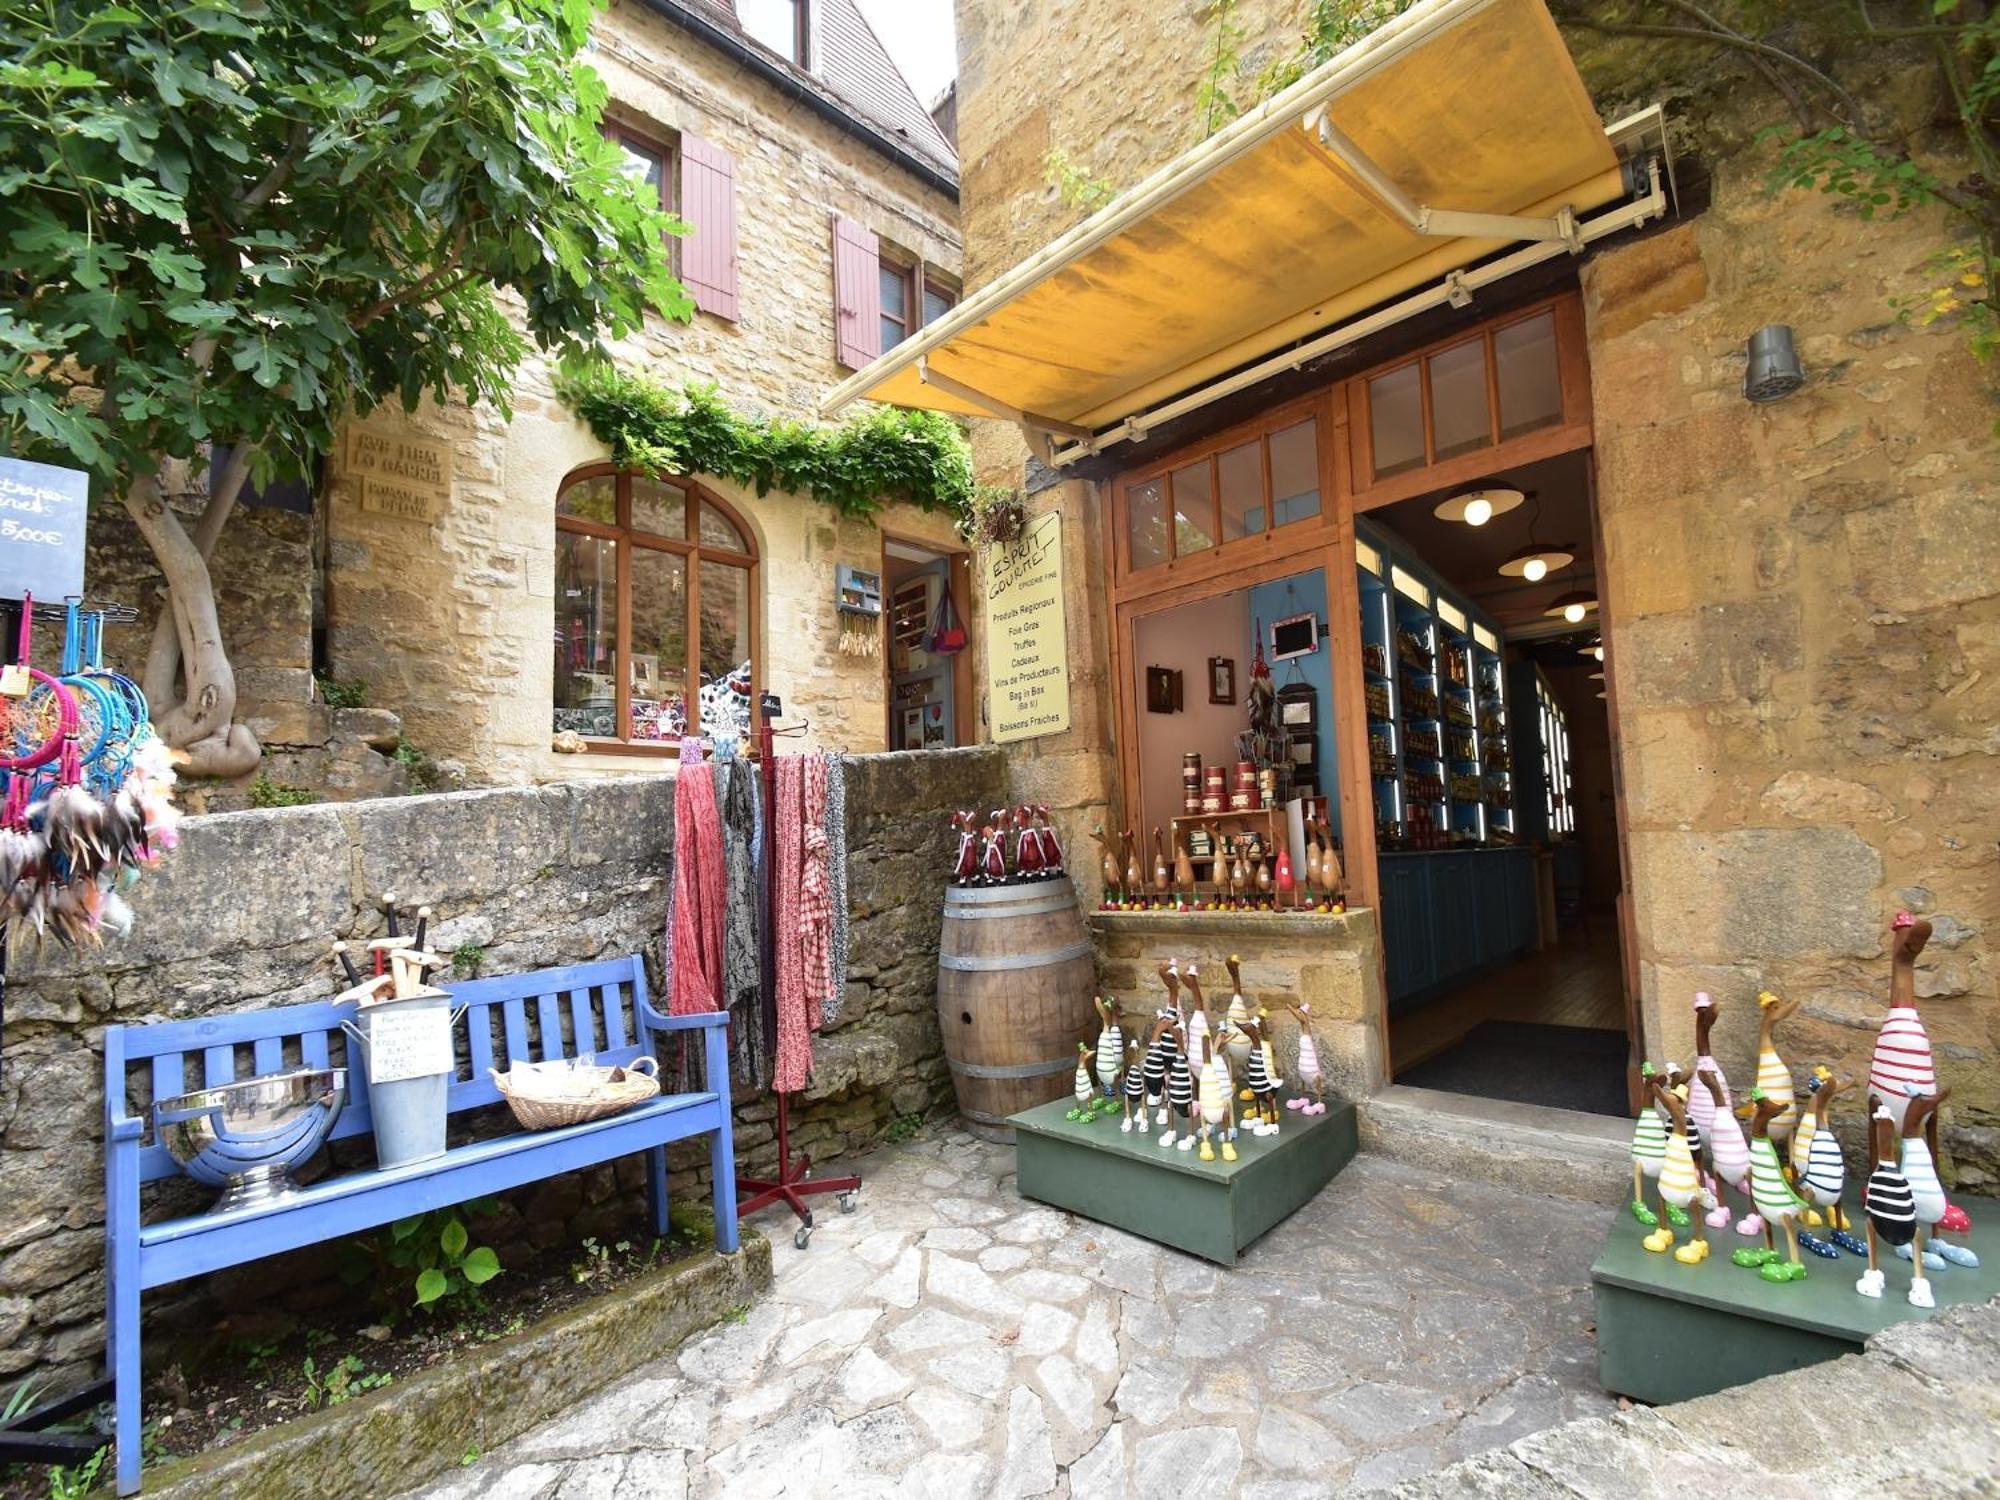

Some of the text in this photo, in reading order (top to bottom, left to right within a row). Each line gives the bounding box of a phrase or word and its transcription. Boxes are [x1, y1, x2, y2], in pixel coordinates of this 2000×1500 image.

[992, 517, 1055, 578] ESPRIT
[988, 536, 1056, 600] GOURMET
[993, 609, 1019, 623] Produits
[1008, 622, 1040, 637] Foie Gras
[1013, 639, 1037, 651] Truffes
[1011, 655, 1040, 668] Cadeaux
[994, 666, 1061, 689] Vins de Producteurs
[1008, 685, 1045, 702] Bag in Box
[999, 719, 1029, 733] Boissons
